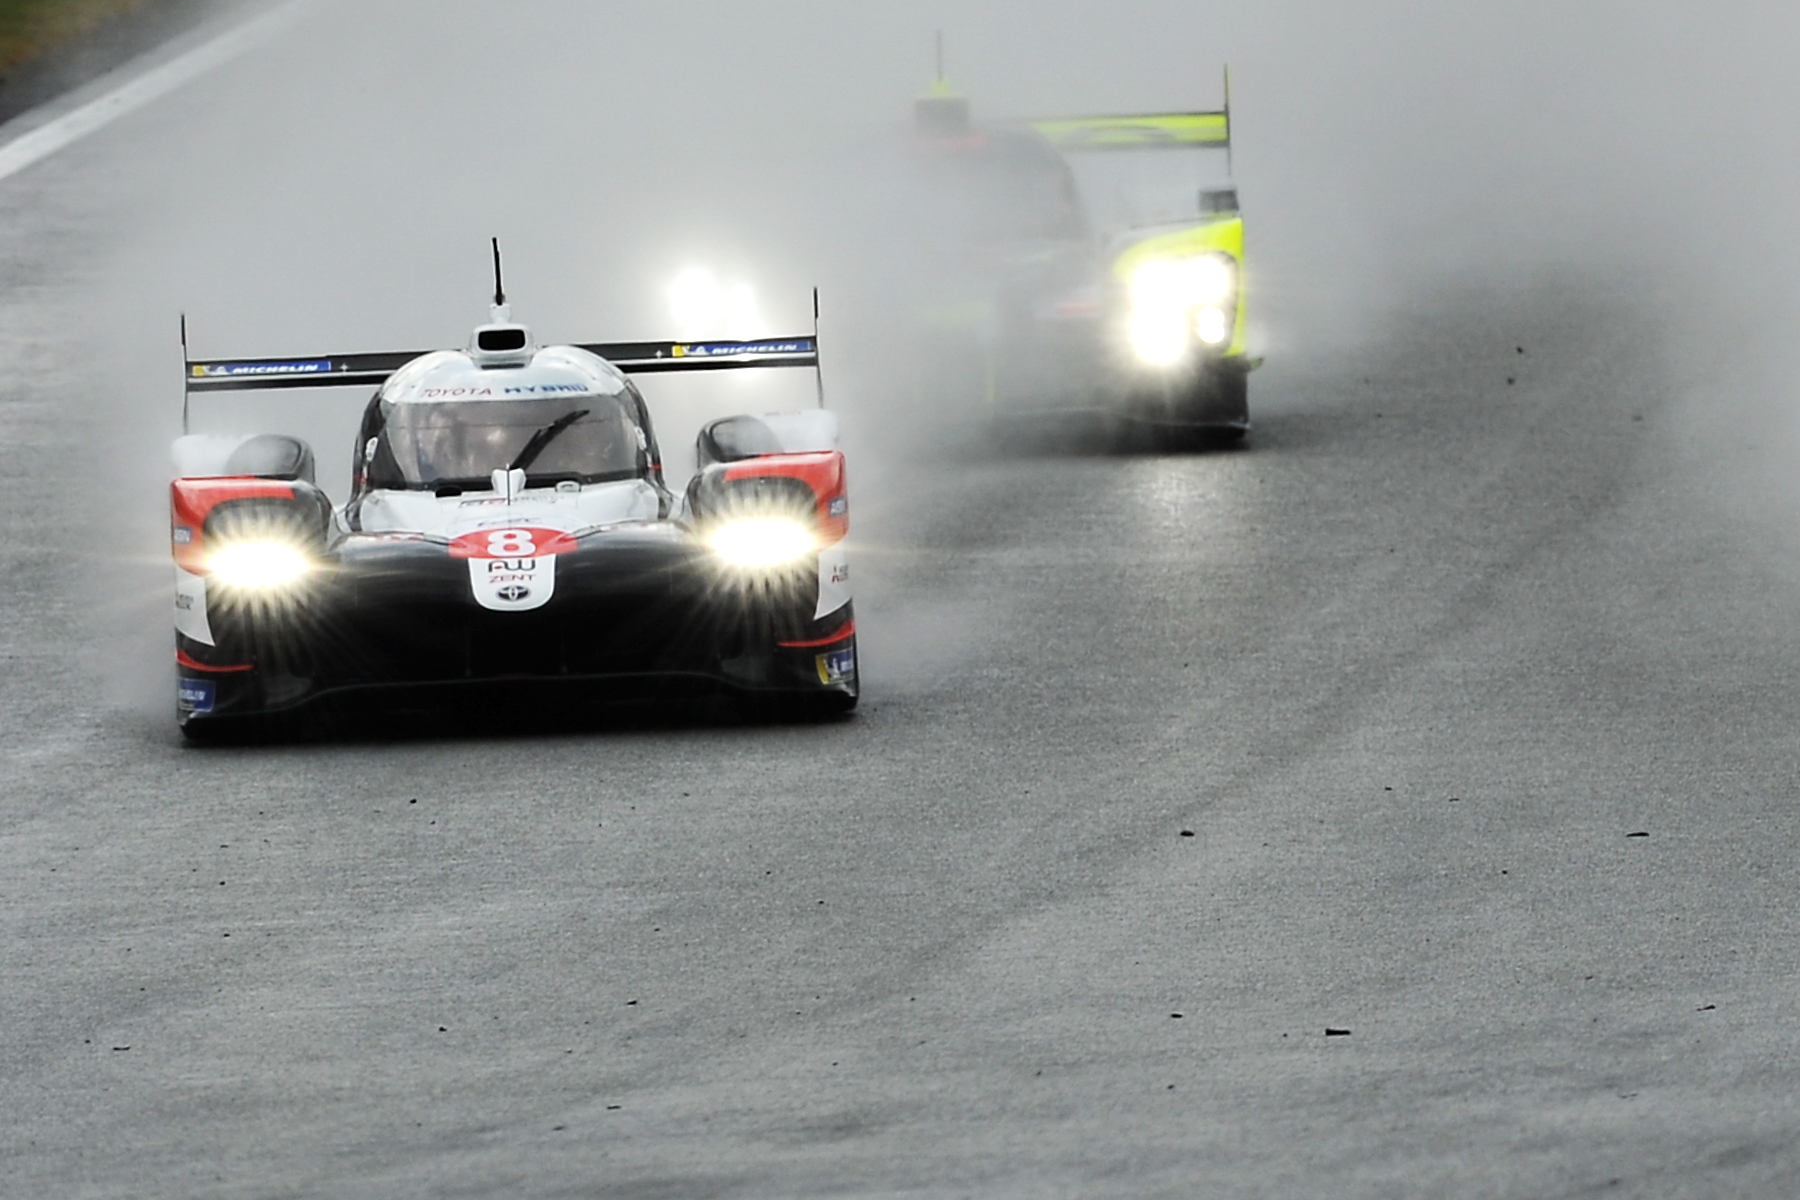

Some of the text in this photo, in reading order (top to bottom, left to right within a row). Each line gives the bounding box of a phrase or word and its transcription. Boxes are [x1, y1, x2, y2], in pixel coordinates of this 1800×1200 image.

[712, 344, 797, 355] MICHELIN
[232, 363, 318, 374] MICHELIN
[422, 387, 492, 398] TOYOTA
[487, 529, 537, 558] 8
[488, 574, 537, 584] ZENT
